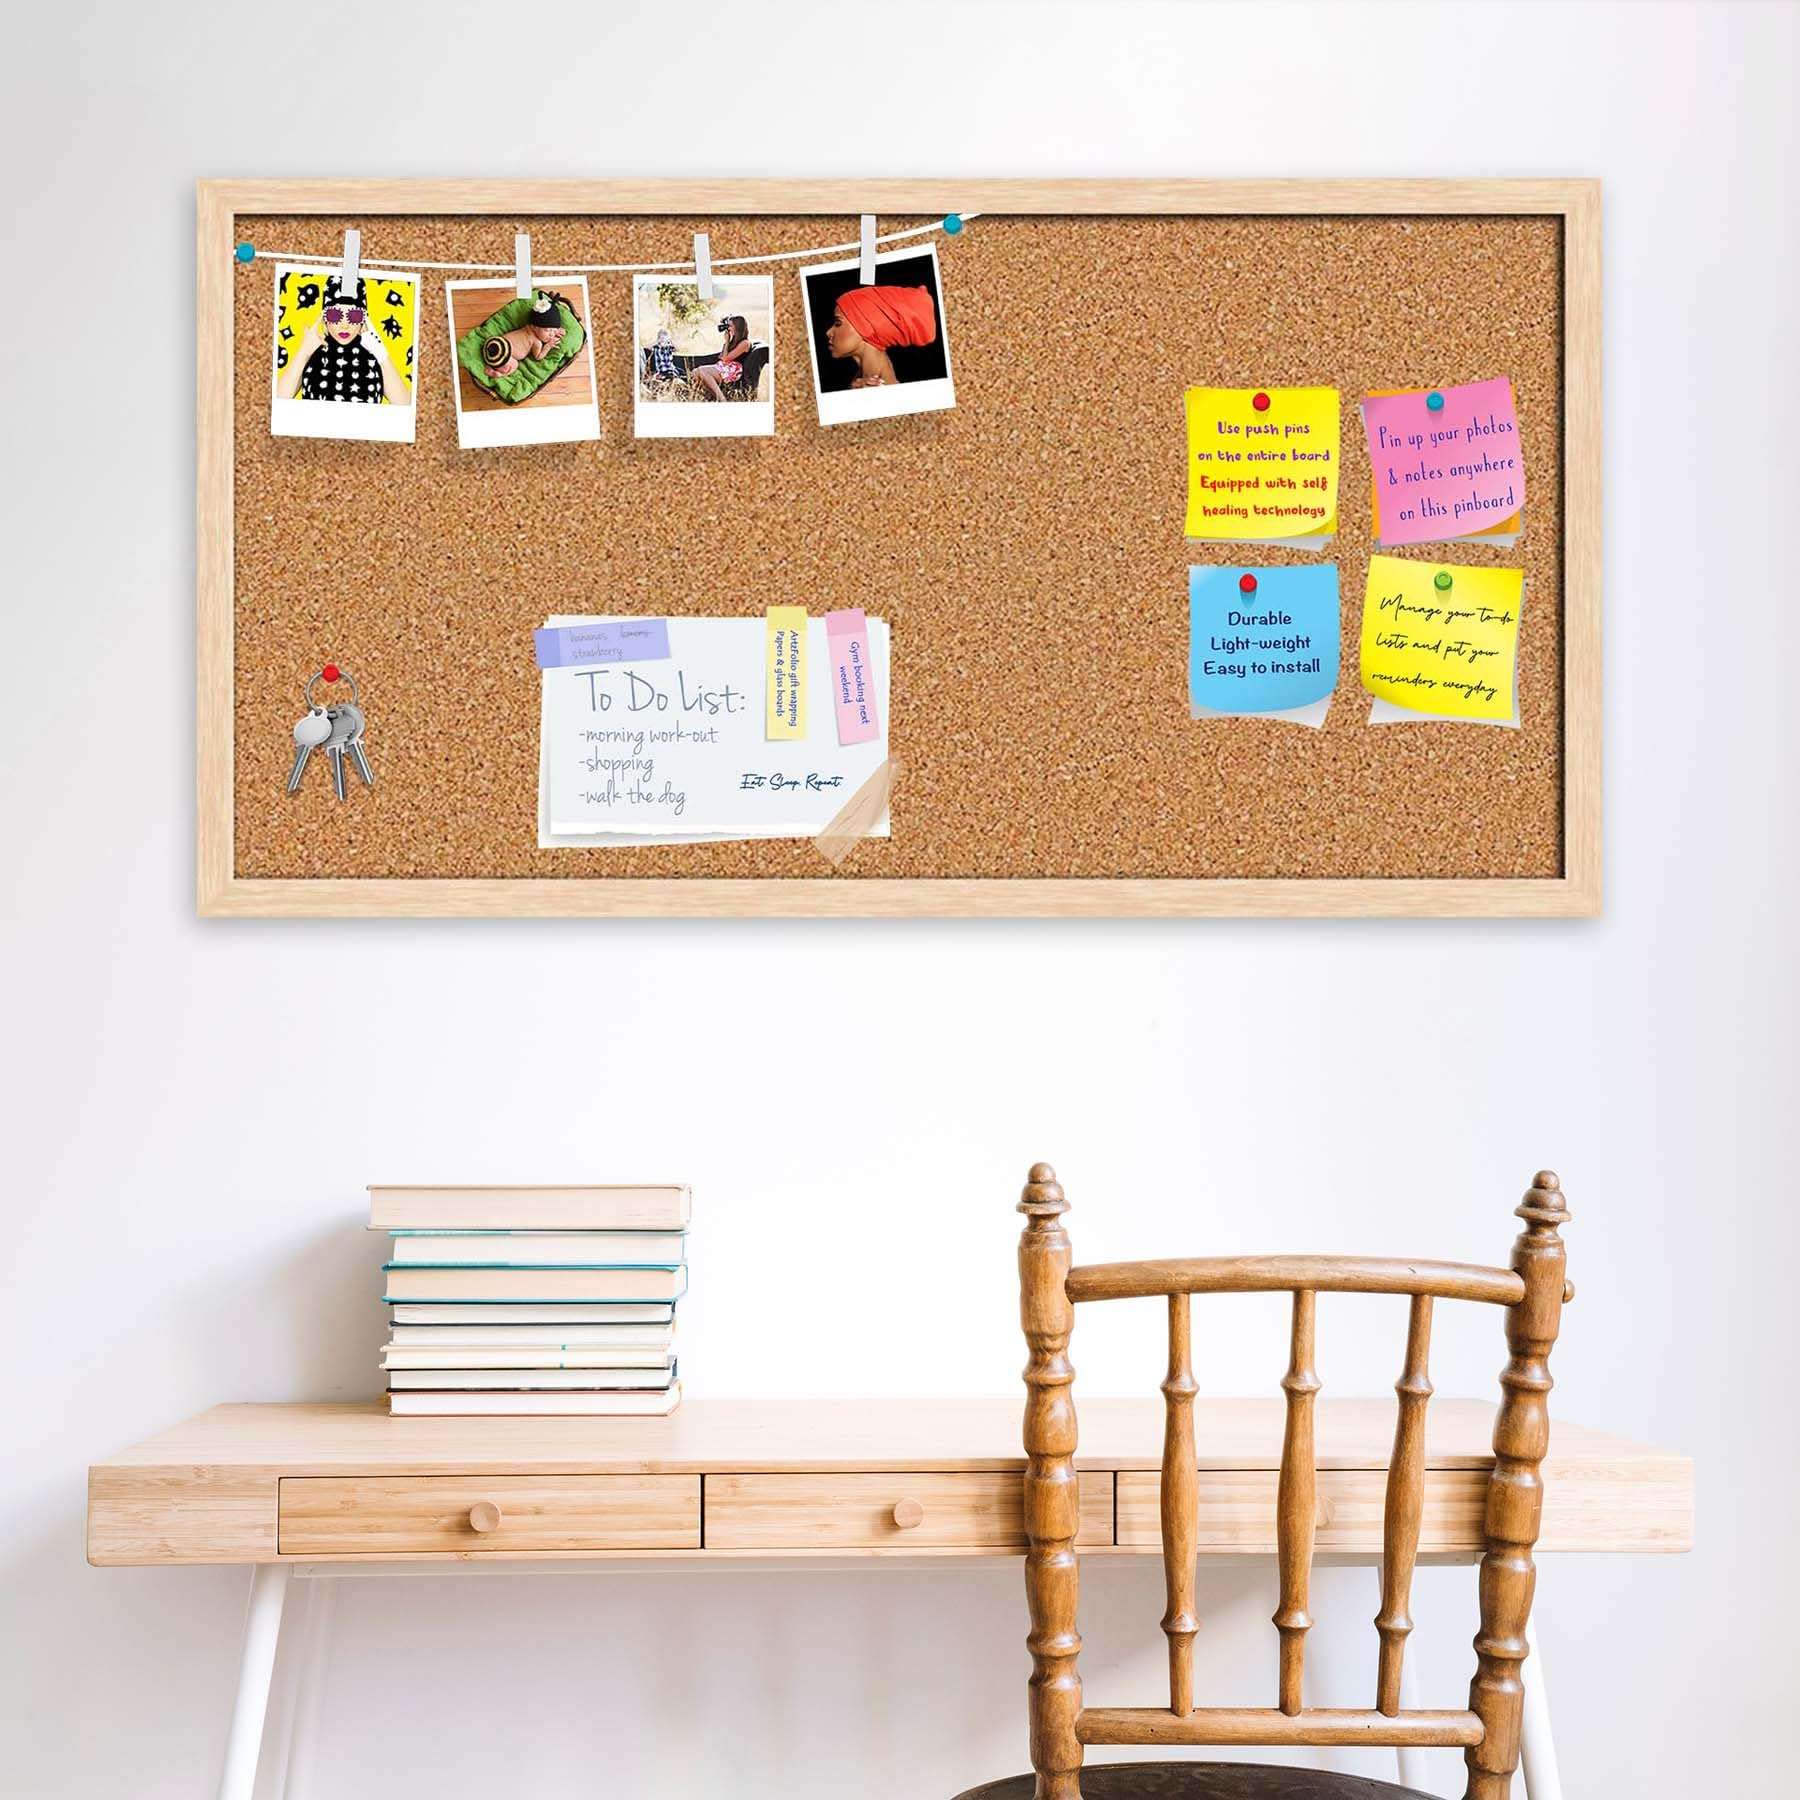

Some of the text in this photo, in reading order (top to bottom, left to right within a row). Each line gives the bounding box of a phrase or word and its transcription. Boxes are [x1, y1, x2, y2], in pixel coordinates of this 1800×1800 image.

[1217, 421, 1310, 438] Use push pins
[1379, 415, 1513, 449] Pin up your photos
[1198, 450, 1330, 461] on the entire board
[1388, 458, 1514, 485] & notes anywhere
[1200, 476, 1328, 492] Equipped with self
[1202, 505, 1326, 519] healing technology
[1400, 487, 1514, 521] on this pinboard
[1228, 611, 1292, 626] Durable
[1380, 593, 1442, 621] Manage
[1444, 608, 1475, 624] your
[775, 631, 784, 656] Papers
[1211, 636, 1311, 652] Light-weight
[1412, 640, 1441, 653] and
[1443, 641, 1472, 660] put
[1468, 645, 1499, 663] your
[775, 668, 785, 687] glass
[788, 672, 800, 686] gift
[1204, 659, 1320, 678] Easy to install
[574, 670, 746, 715] To Do List:
[840, 666, 853, 704] weekend
[849, 641, 870, 724] Gym booking next
[776, 690, 785, 717] boards
[788, 690, 797, 727] wrapping
[649, 721, 719, 744] work-out
[739, 774, 767, 789] Eat
[626, 779, 654, 804] the
[658, 781, 686, 815] dog
